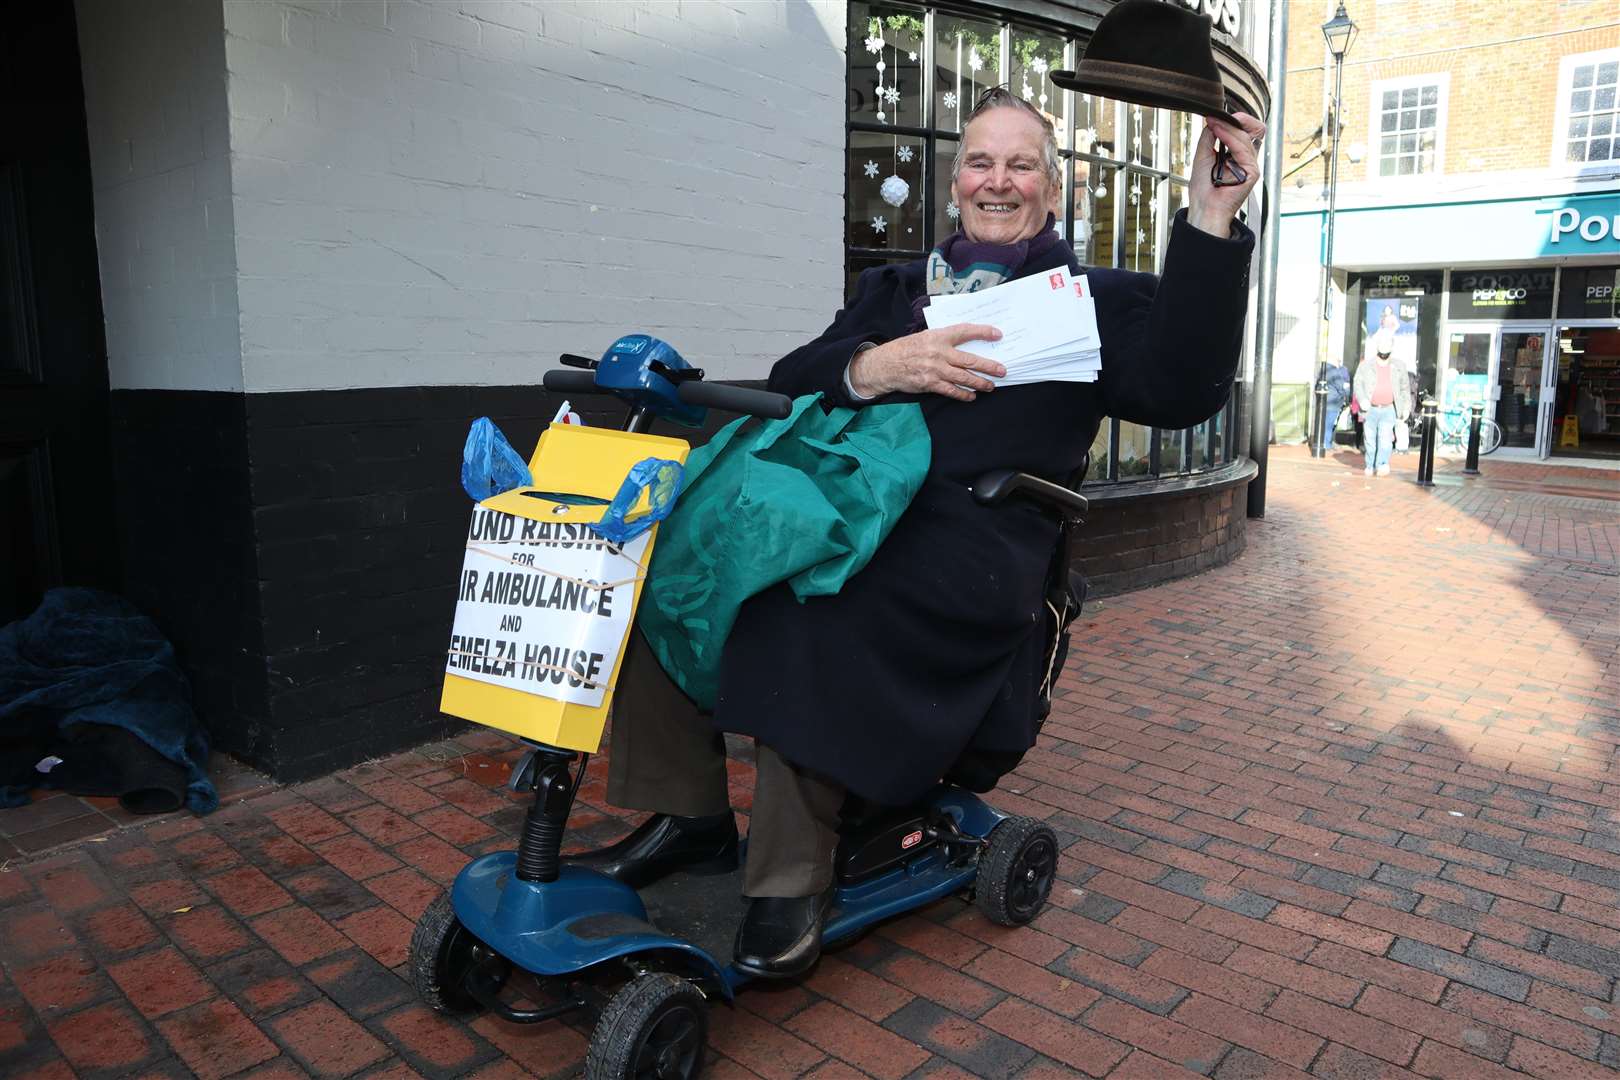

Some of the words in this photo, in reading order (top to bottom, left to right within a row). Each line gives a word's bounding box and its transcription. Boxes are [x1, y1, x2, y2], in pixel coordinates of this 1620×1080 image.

[511, 552, 535, 567] FOR
[480, 571, 614, 617] AMBULANCE
[500, 615, 522, 632] AND
[521, 643, 603, 690] HOUSE
